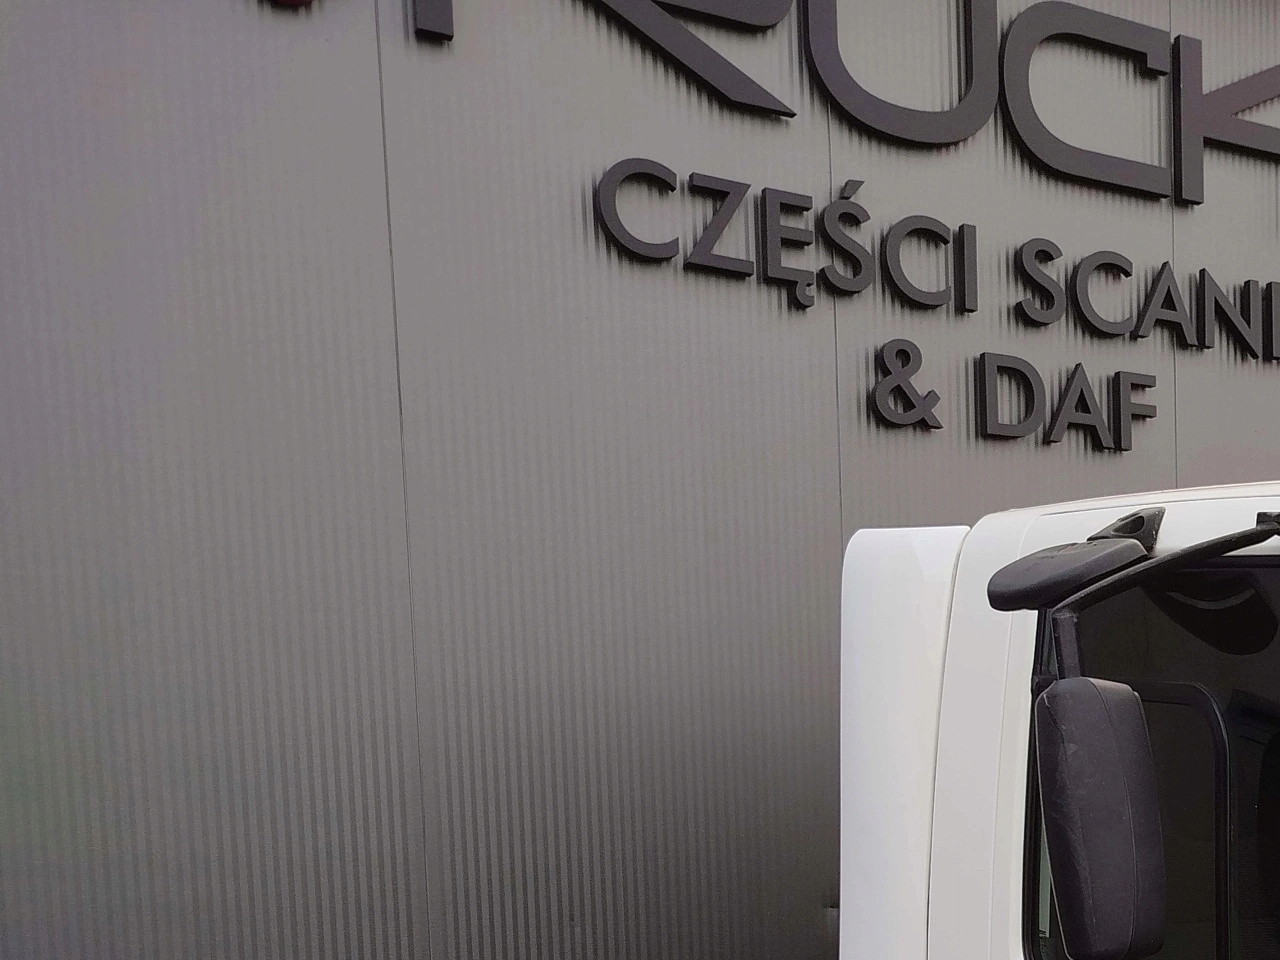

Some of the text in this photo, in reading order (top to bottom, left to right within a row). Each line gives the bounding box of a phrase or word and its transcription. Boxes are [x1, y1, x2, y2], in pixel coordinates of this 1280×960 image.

[598, 157, 978, 312] CZĘŚCI
[874, 338, 1157, 451] & DAF
